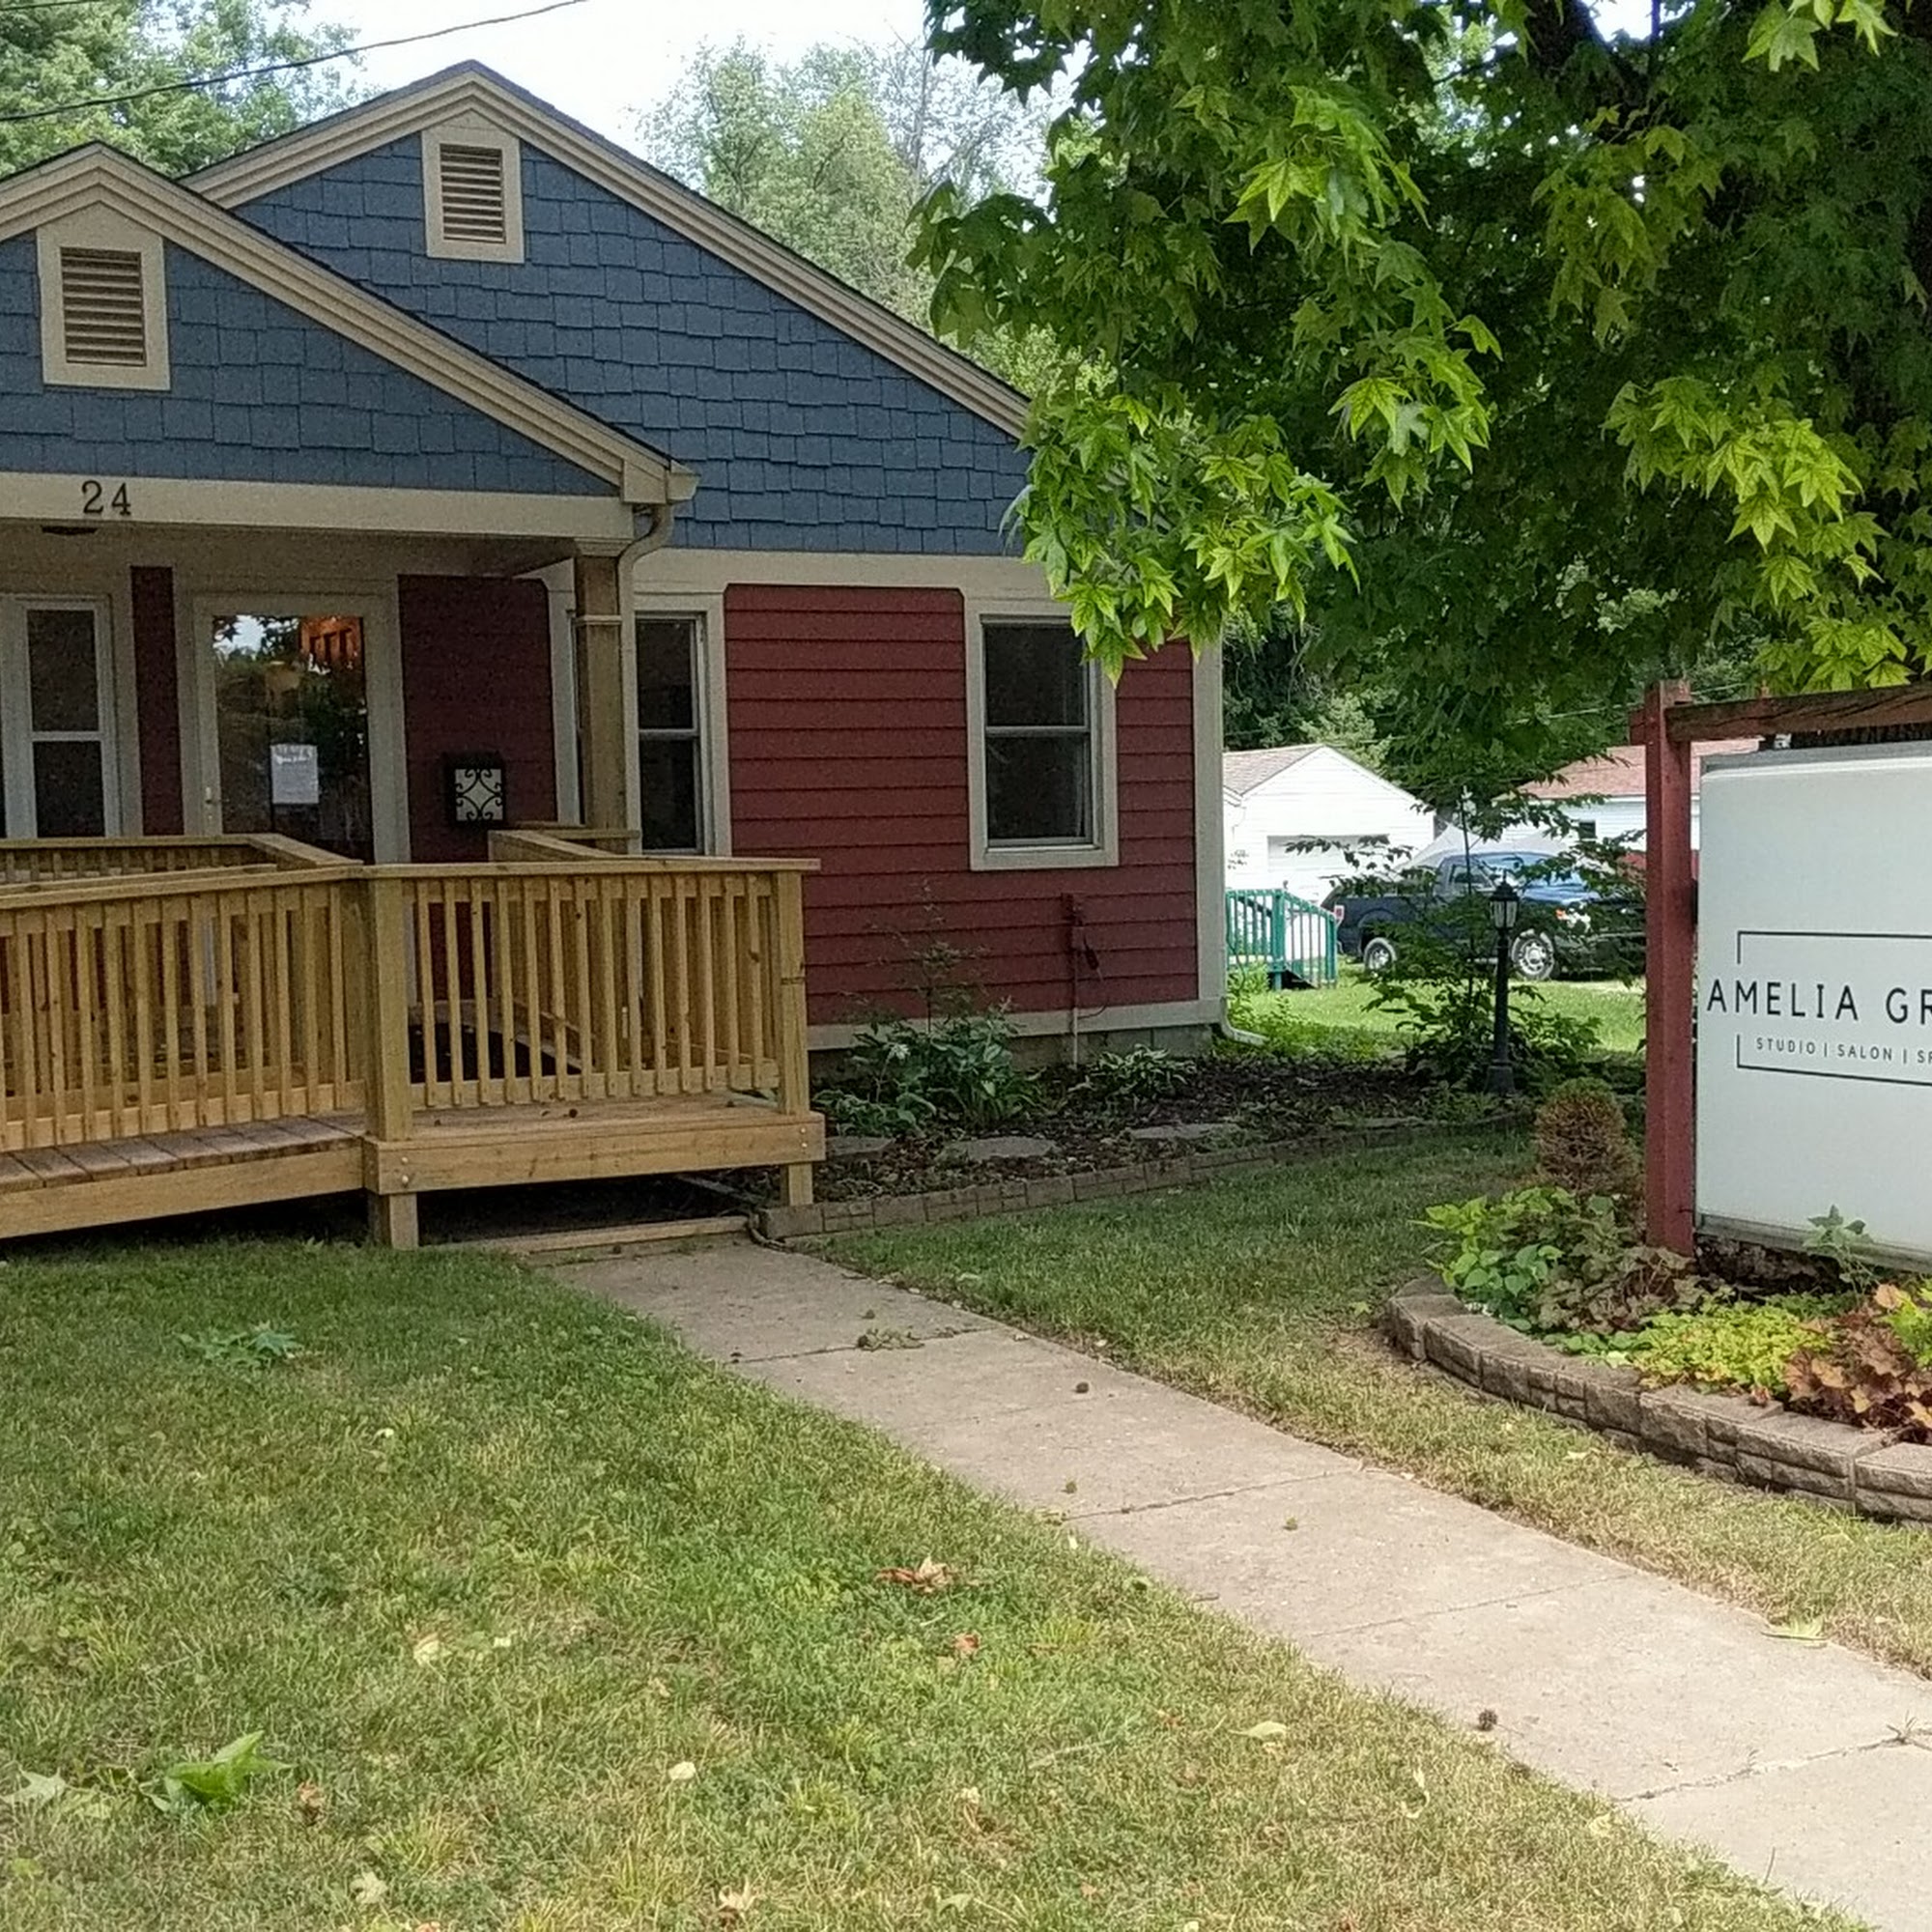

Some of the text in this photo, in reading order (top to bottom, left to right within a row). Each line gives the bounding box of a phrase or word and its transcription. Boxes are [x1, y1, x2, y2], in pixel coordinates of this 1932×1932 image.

[81, 479, 131, 516] 24
[1707, 979, 1859, 1021] AMELIA
[1756, 1037, 1816, 1055] STUDIO
[1837, 1044, 1892, 1062] SALON
